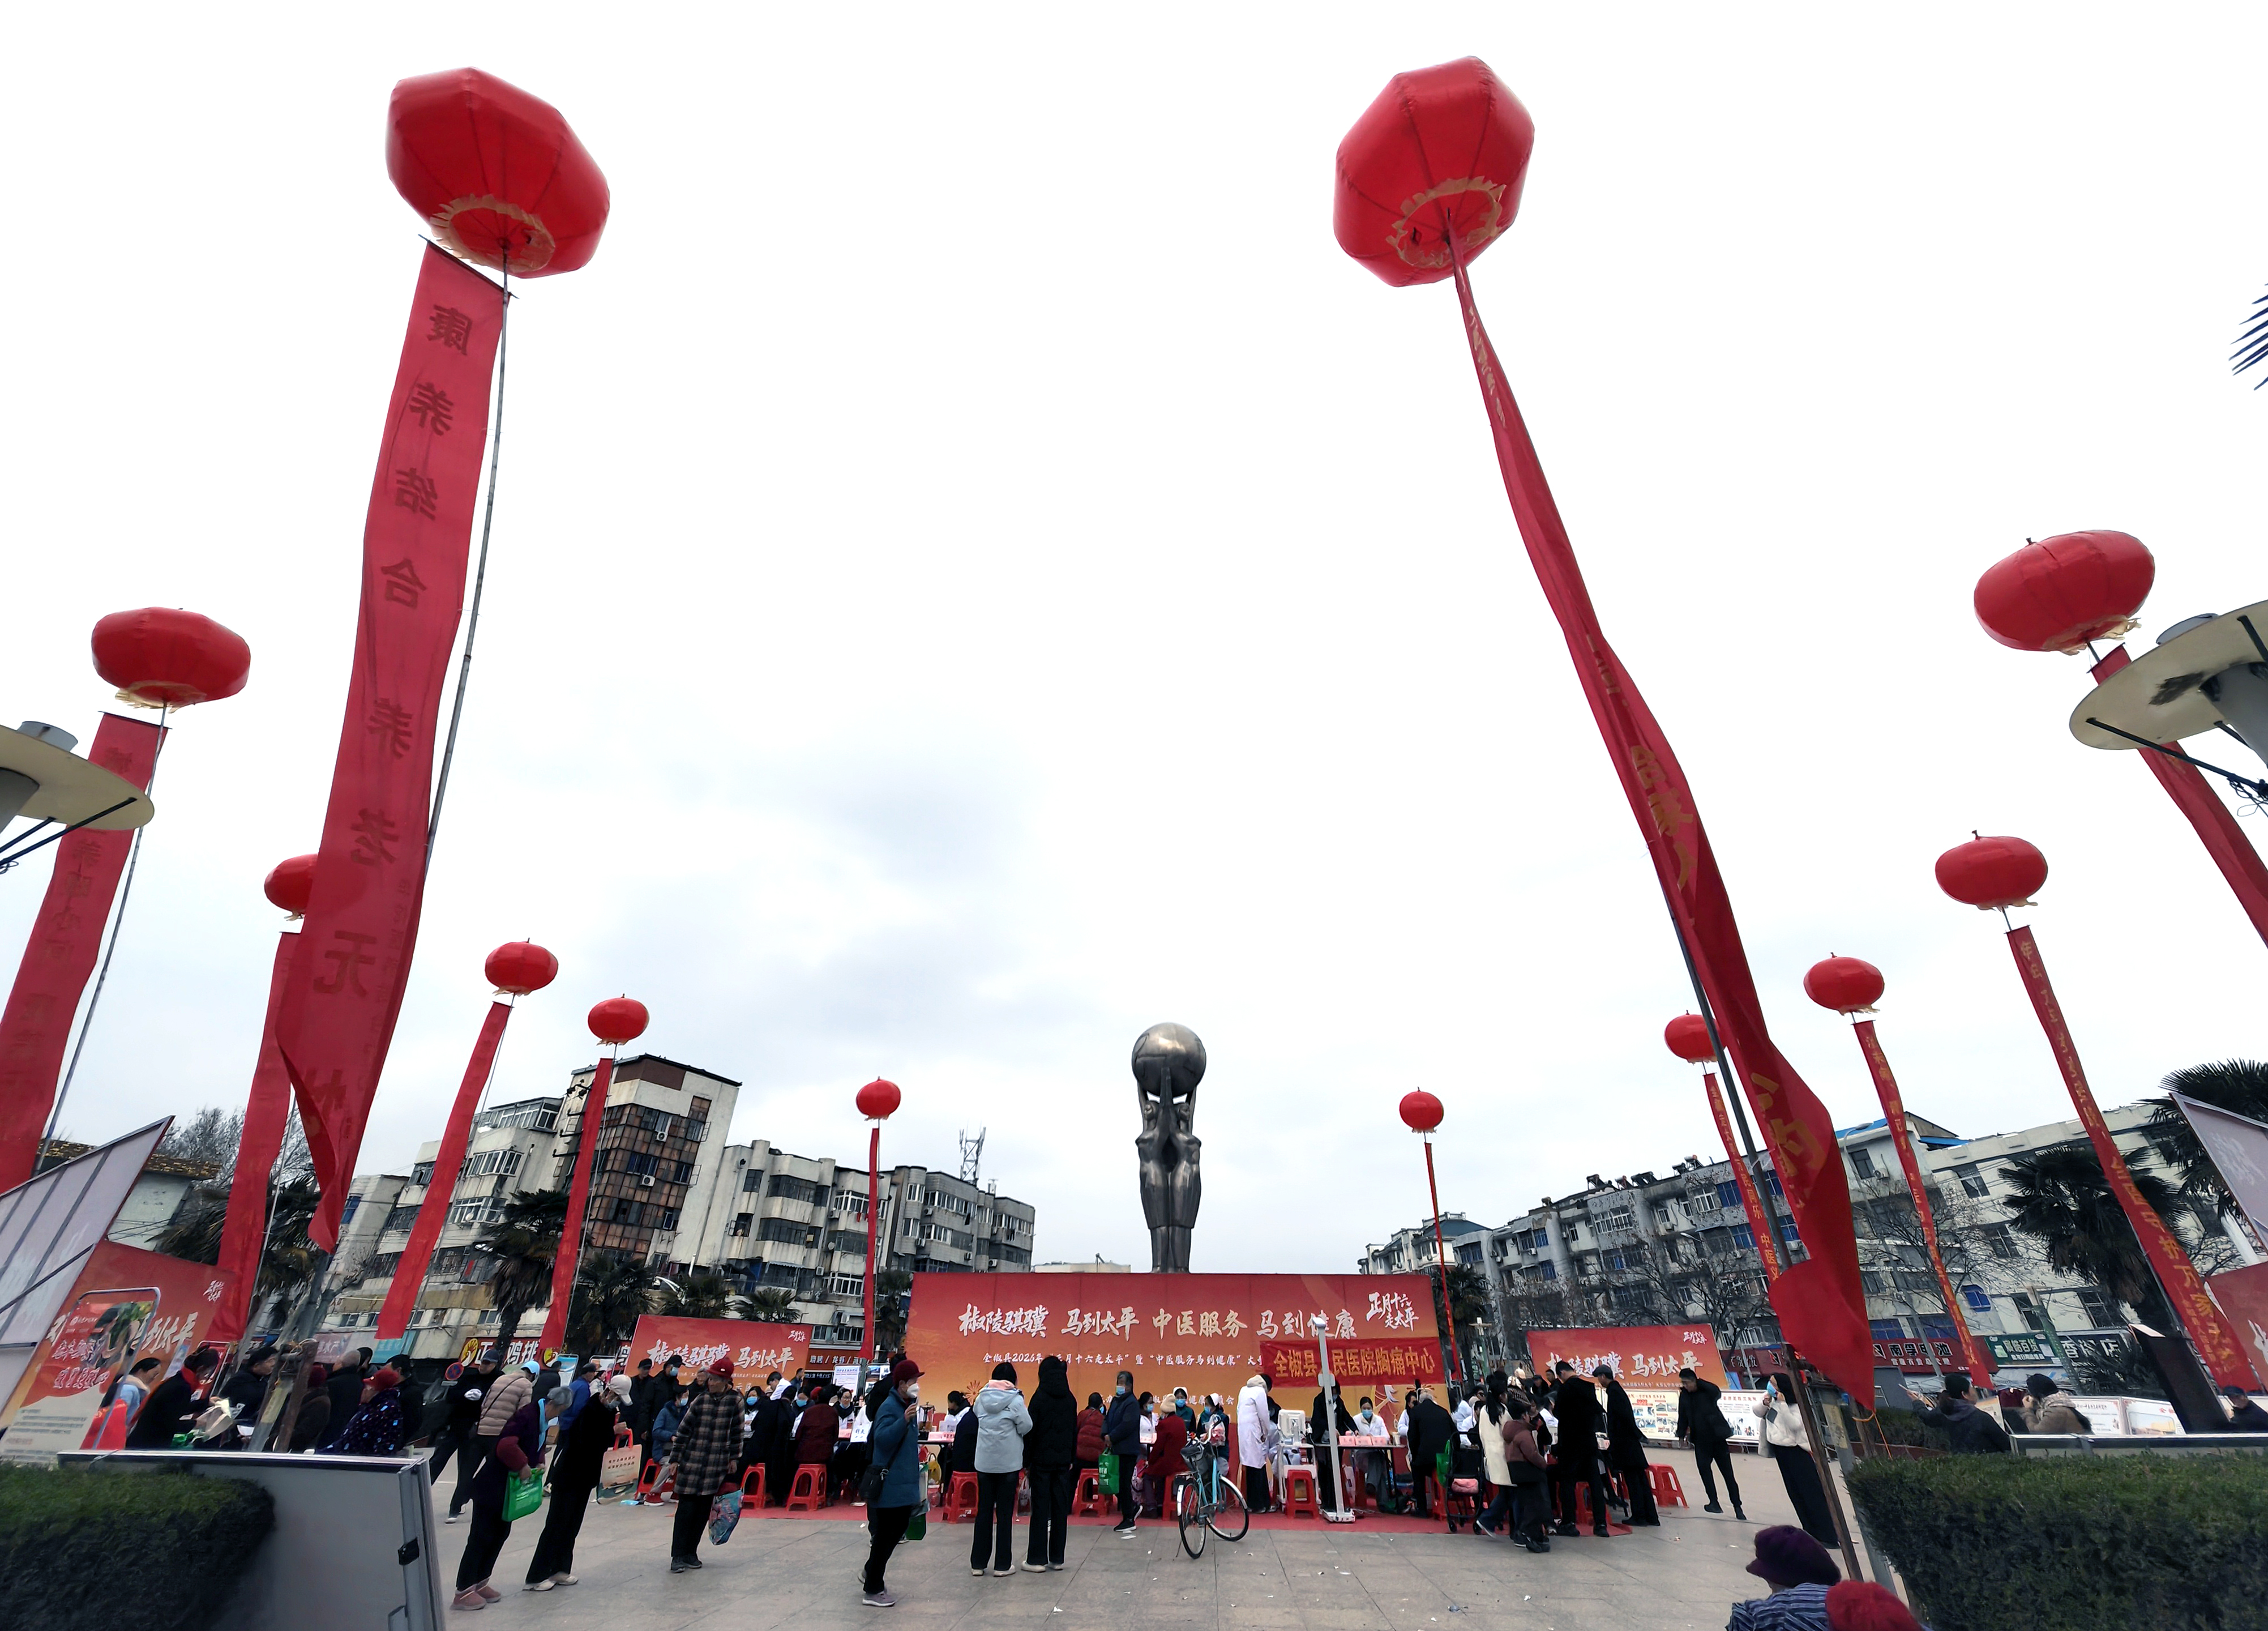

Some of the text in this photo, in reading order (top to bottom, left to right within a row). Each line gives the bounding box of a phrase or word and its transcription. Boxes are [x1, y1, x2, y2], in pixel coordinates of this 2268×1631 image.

[1366, 1291, 1413, 1321] 正月十六
[1385, 1307, 1419, 1332] 走太平
[958, 1303, 1358, 1341] 椒陵骐骥 马到太平 中医服务 马到健康
[474, 1340, 540, 1367] 正鸡排
[734, 1346, 795, 1373] 马到太平
[1273, 1347, 1436, 1378] 全椒县民医院胸痛中心
[1631, 1351, 1704, 1377] 马到太平
